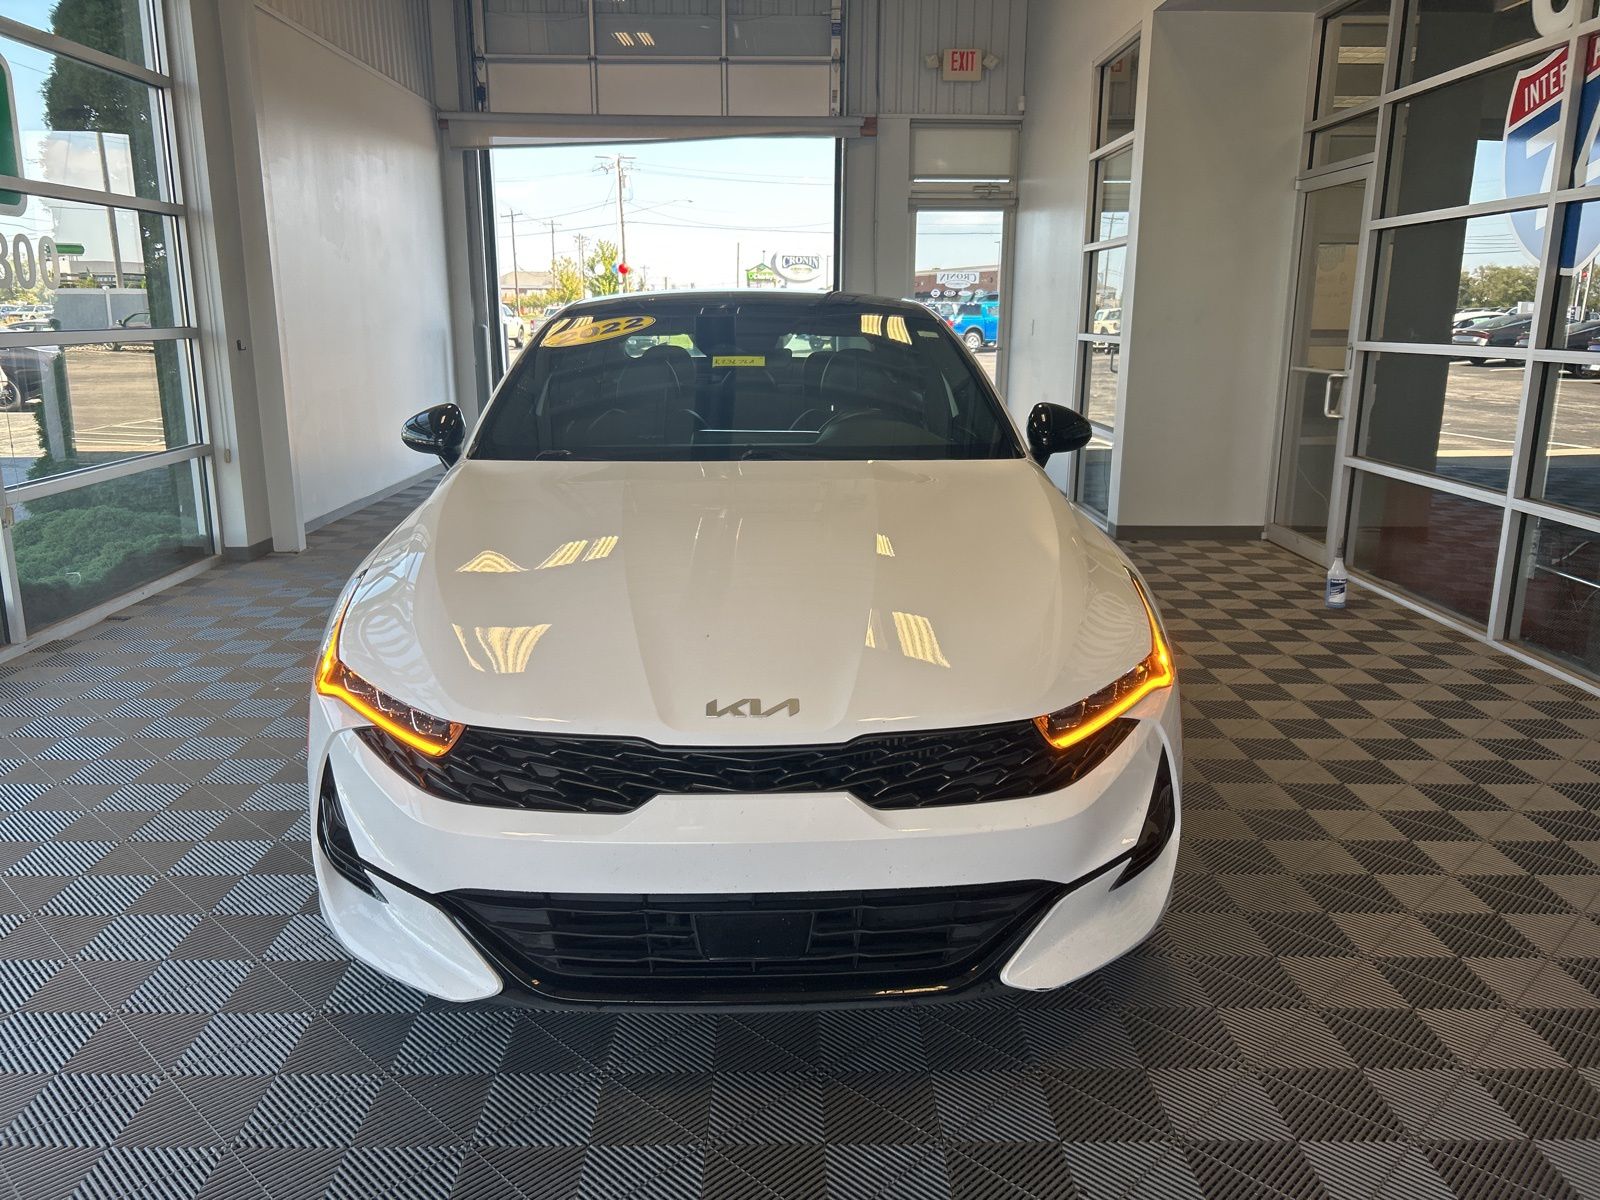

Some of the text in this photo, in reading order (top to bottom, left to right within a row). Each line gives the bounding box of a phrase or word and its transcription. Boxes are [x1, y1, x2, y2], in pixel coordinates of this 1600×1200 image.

[951, 51, 976, 72] EXIT
[782, 255, 819, 269] CRONIN
[554, 316, 644, 346] 2022
[705, 698, 801, 718] KIA
